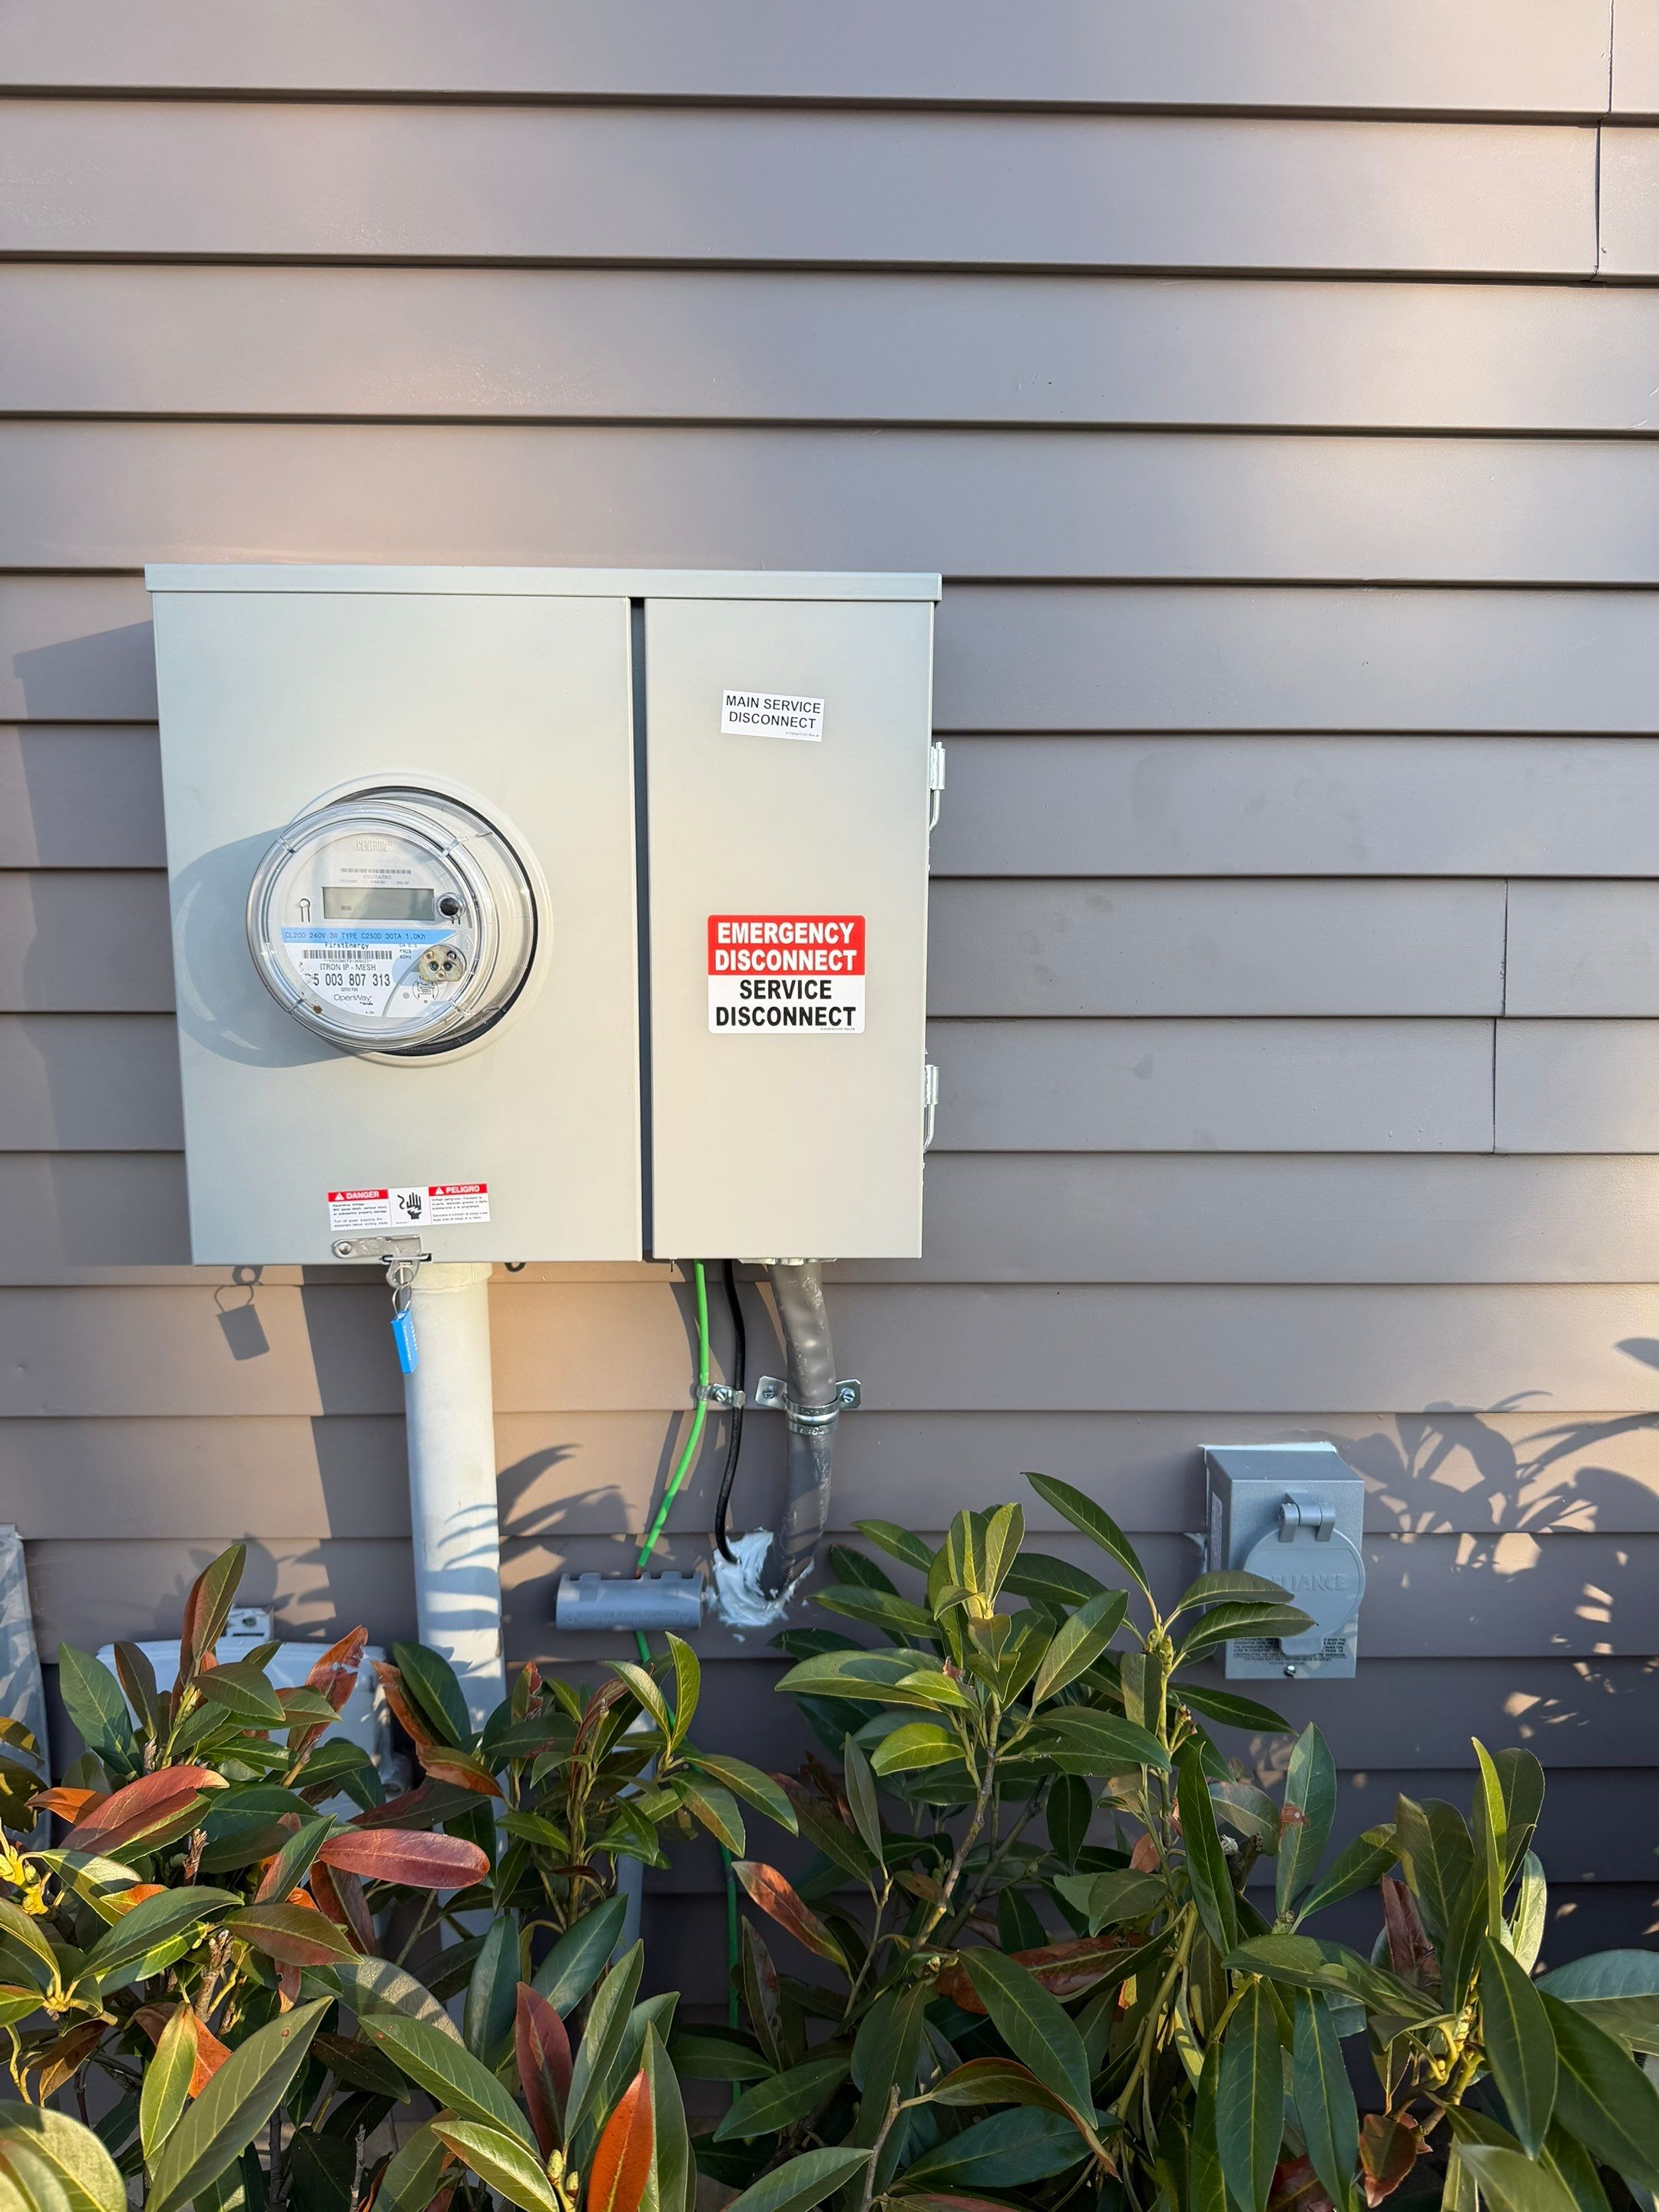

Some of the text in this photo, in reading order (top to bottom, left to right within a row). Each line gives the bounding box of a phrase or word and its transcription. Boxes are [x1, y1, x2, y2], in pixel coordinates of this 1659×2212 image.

[726, 695, 821, 714] MAIN SERVICE
[729, 711, 816, 729] DISCONNECT
[717, 922, 855, 944] EMERGENCY
[715, 949, 857, 972] DISCONNECT
[325, 973, 343, 986] 003
[349, 973, 366, 986] 807
[373, 973, 390, 986] 313
[739, 979, 832, 999] SERVICE
[716, 1006, 856, 1026] DISCONNECT
[346, 1190, 379, 1200] DANGER
[445, 1184, 480, 1194] PELIGRO
[1271, 1573, 1346, 1591] LIANCE
